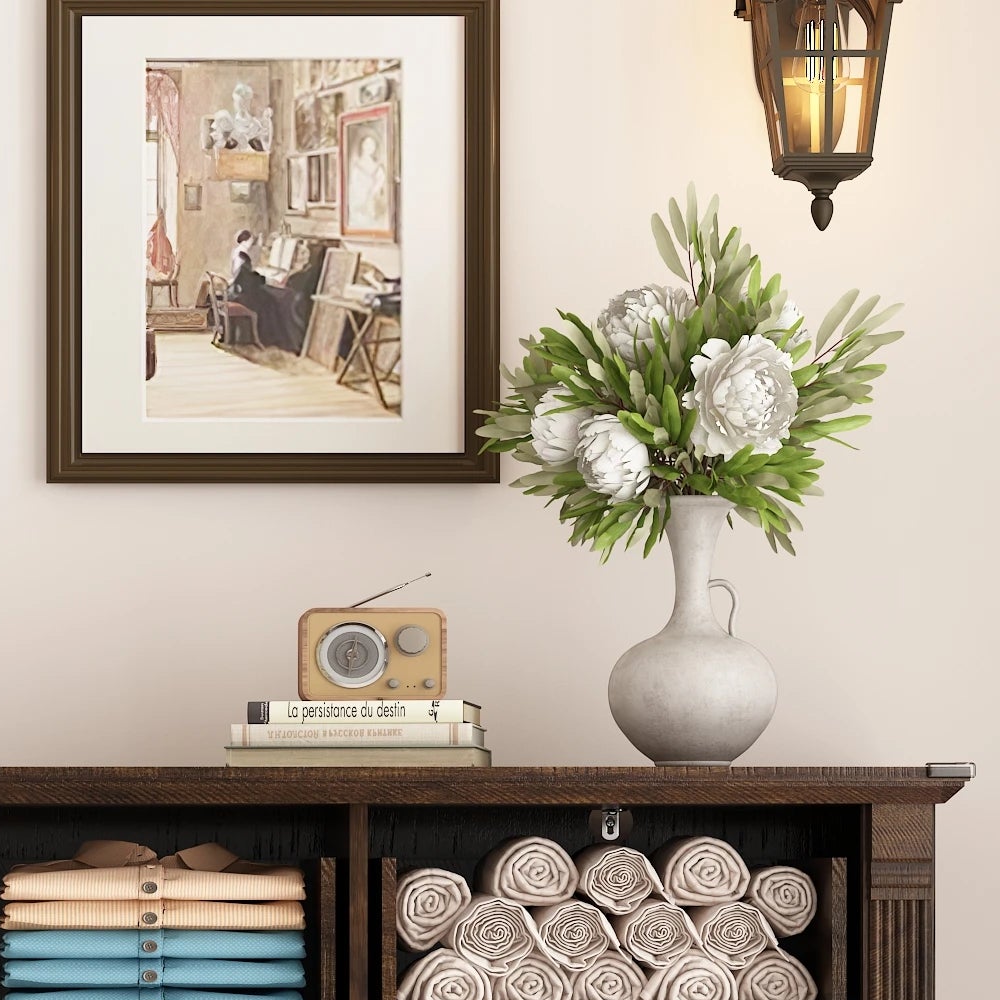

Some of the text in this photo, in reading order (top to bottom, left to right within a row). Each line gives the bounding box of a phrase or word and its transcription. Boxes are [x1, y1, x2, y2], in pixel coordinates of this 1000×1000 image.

[287, 701, 298, 718] La
[302, 701, 358, 724] persistance
[360, 701, 374, 718] du
[377, 701, 406, 718] destin
